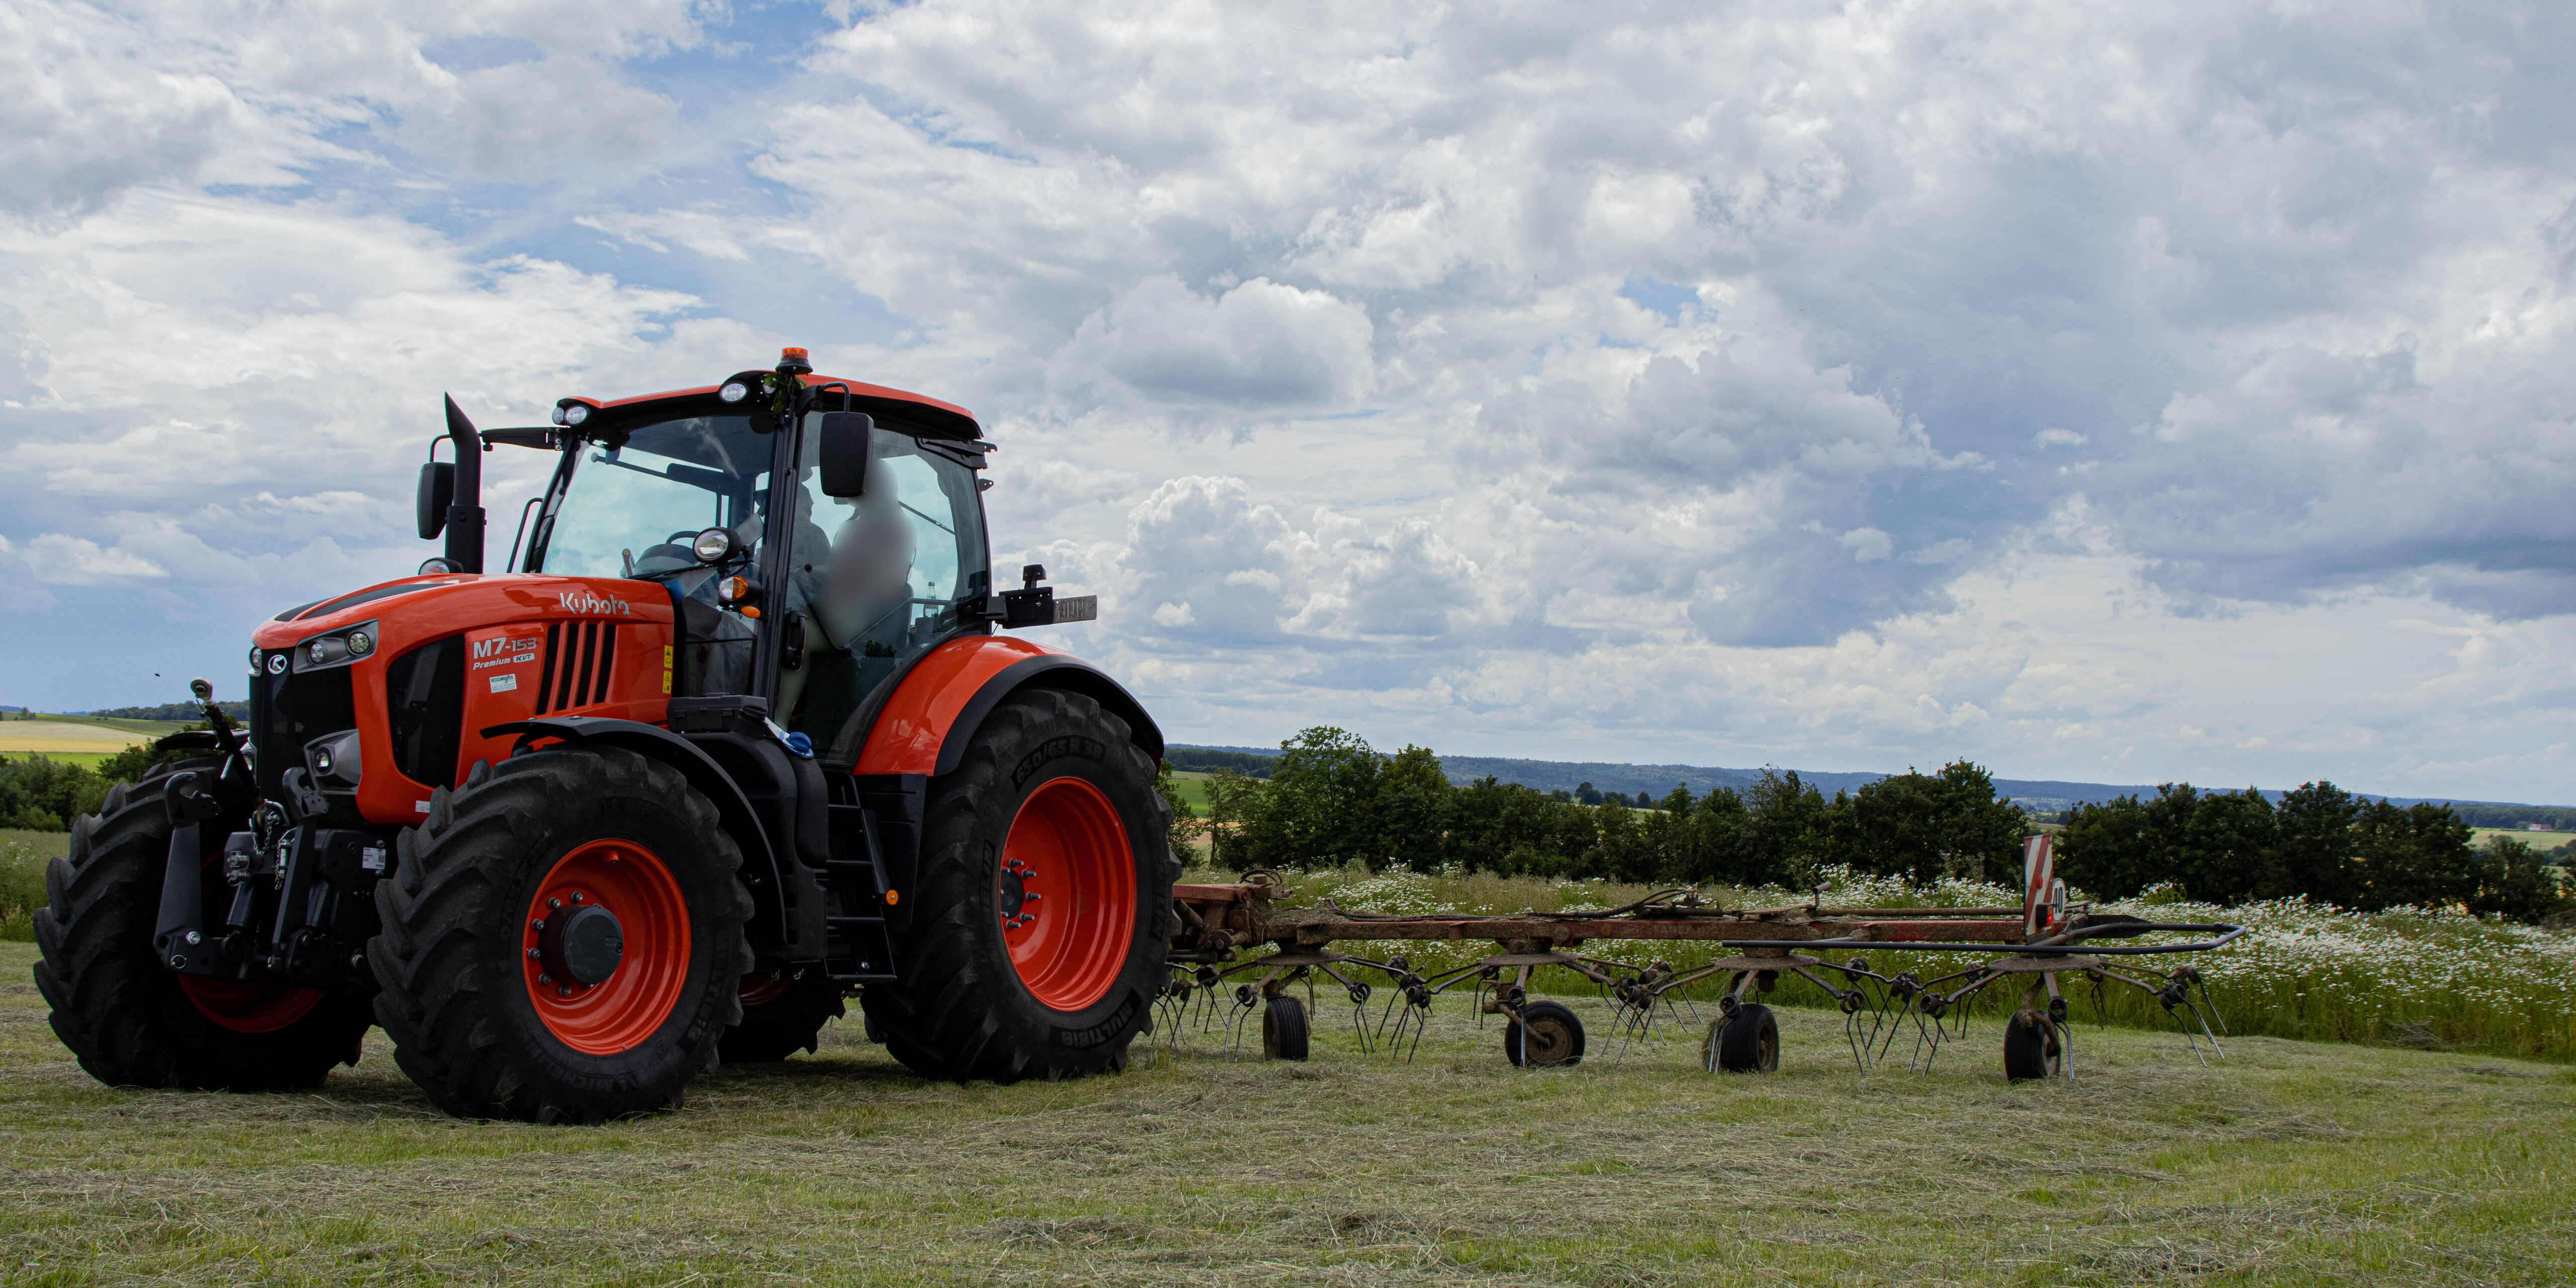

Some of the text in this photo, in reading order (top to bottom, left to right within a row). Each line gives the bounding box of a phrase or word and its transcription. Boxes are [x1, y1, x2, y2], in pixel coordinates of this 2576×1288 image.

[559, 592, 629, 615] Kubota
[473, 637, 536, 659] M7-153
[473, 657, 510, 670] Premium
[1016, 738, 1102, 783] 650/65 R 38
[2053, 887, 2063, 914] 40
[688, 929, 728, 1041] MULTIBIB
[1061, 1001, 1134, 1048] MULTIBIB
